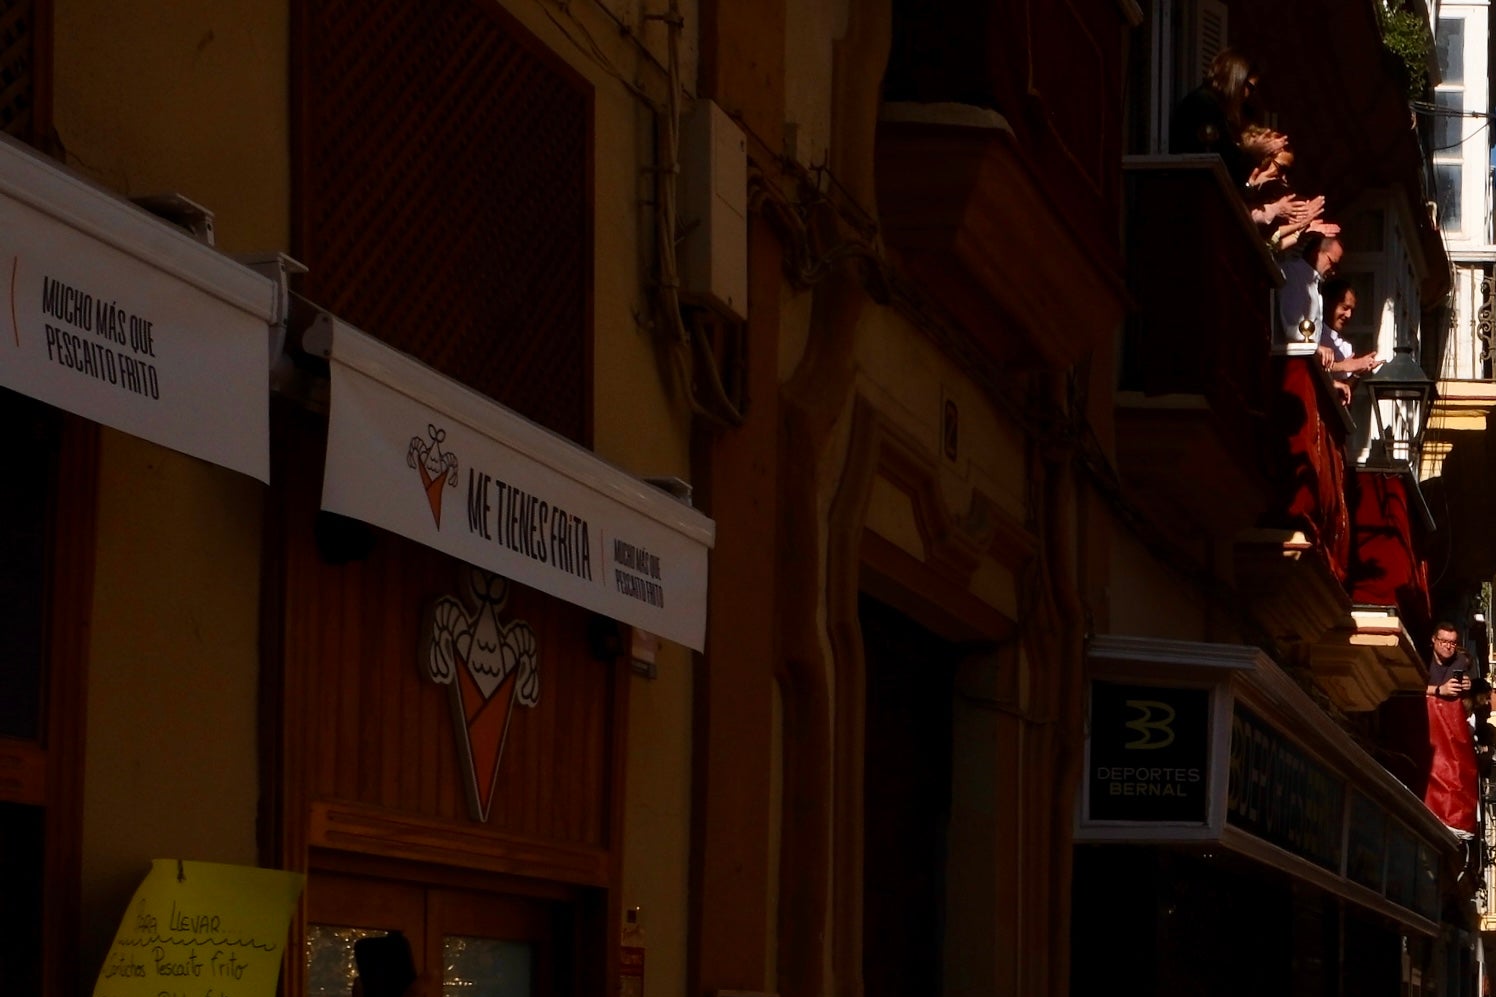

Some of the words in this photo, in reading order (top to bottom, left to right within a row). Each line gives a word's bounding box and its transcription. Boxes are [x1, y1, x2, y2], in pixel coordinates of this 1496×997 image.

[43, 276, 92, 331] MUCHO
[96, 300, 126, 346] MÁS
[130, 315, 155, 358] QUE
[45, 323, 117, 385] PESCAITO
[118, 353, 159, 400] FRITO
[468, 467, 492, 541] ME
[496, 480, 548, 564] TIENES
[614, 538, 635, 571] MUCHO
[615, 568, 646, 603] PESCAITO
[1096, 766, 1201, 783] DEPORTES
[1109, 782, 1188, 798] BERNAL
[152, 946, 204, 977] Pescaito
